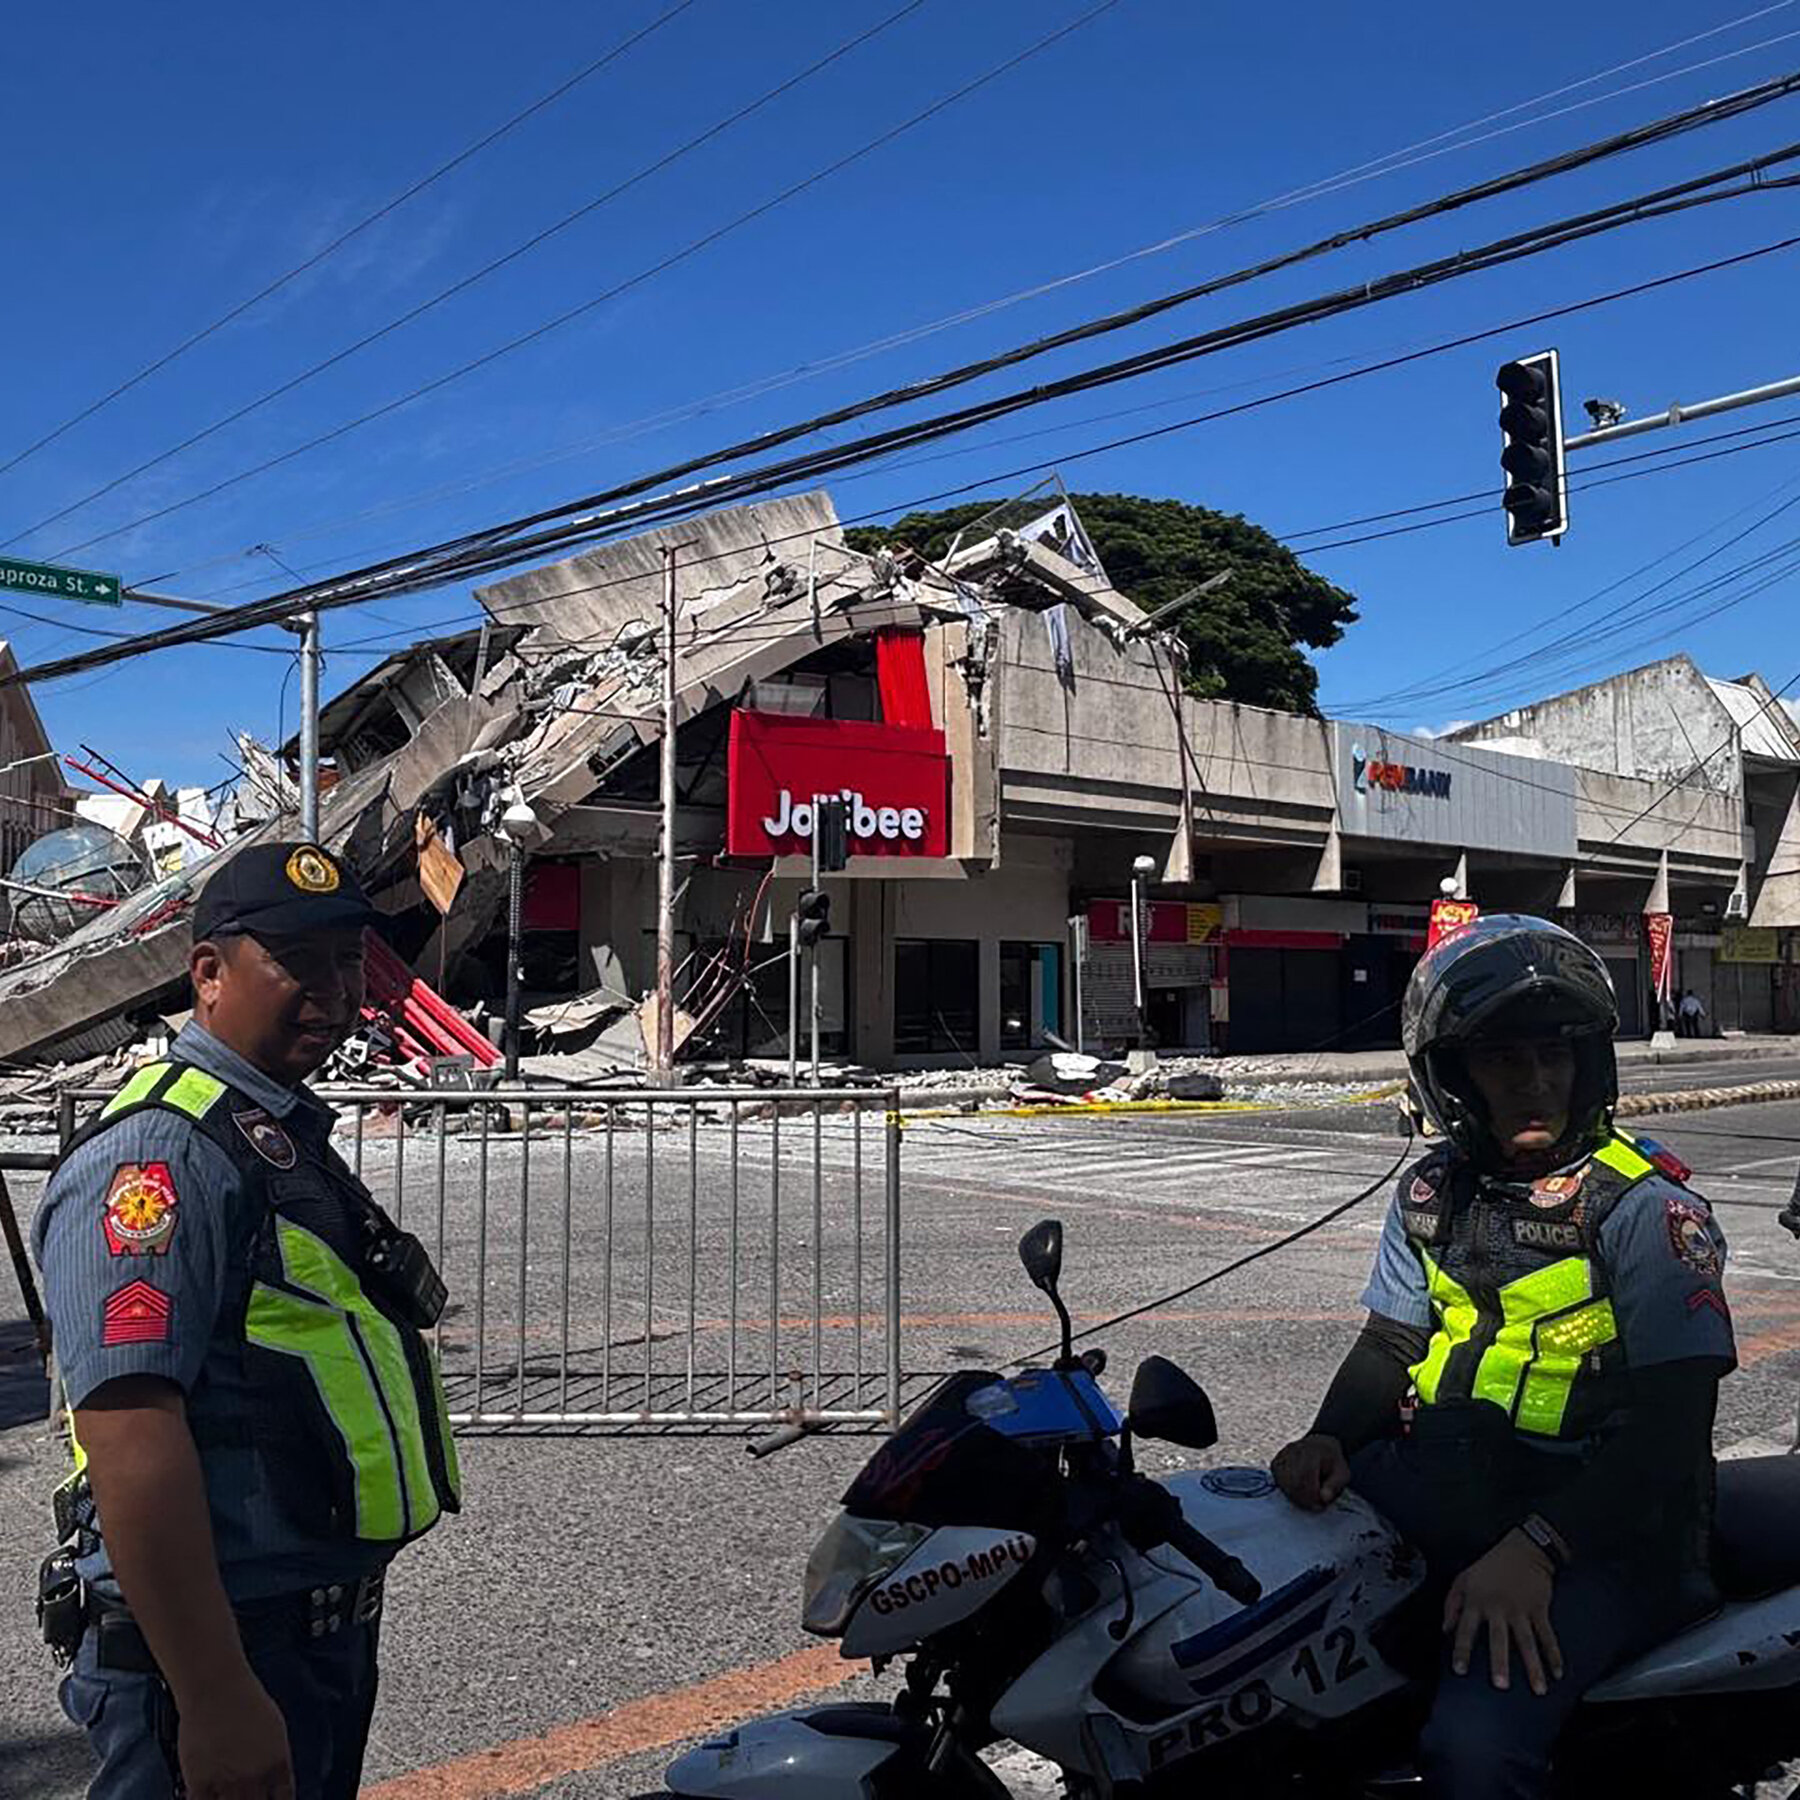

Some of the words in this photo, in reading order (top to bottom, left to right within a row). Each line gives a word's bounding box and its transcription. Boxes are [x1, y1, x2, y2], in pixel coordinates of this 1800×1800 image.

[66, 576, 88, 593] St.
[764, 789, 924, 839] Joibee
[1515, 1220, 1578, 1245] POLICE
[1149, 1679, 1272, 1770] PRO
[1292, 1625, 1370, 1694] 12
